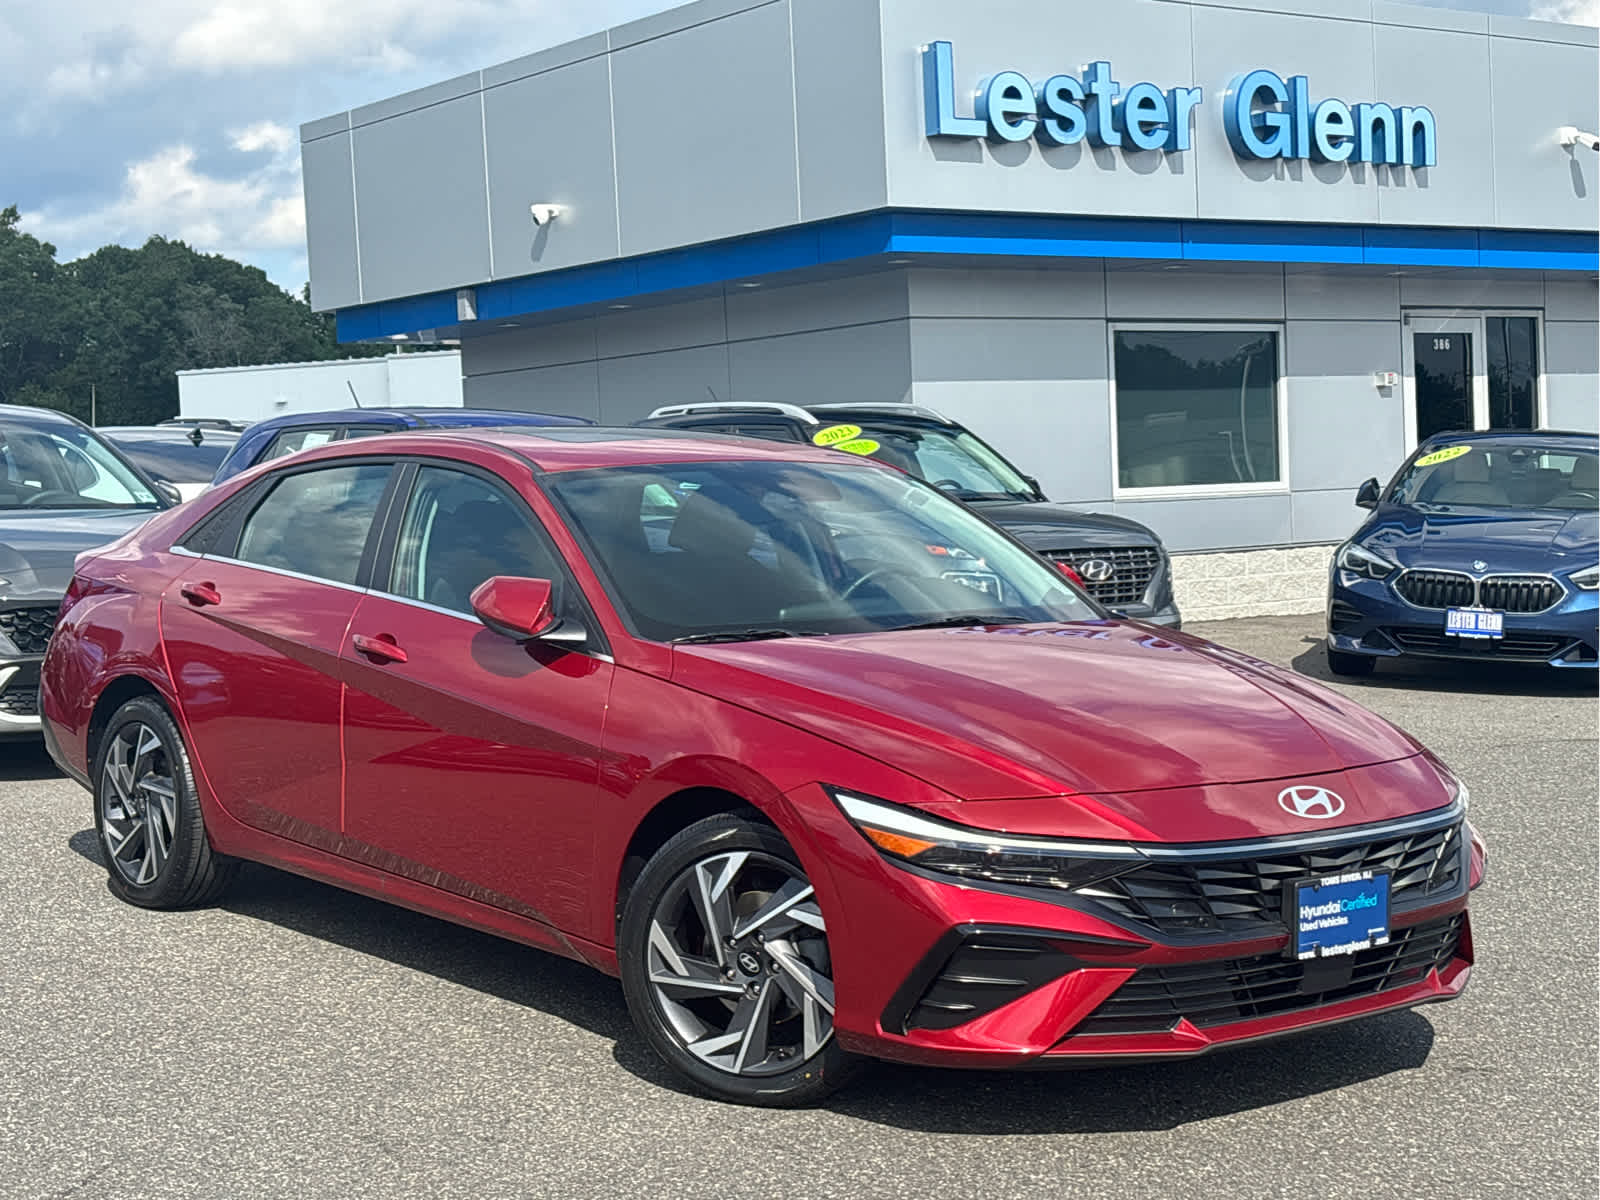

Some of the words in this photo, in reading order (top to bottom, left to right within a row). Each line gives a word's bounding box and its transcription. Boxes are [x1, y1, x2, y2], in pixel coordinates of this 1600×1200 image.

[922, 41, 1202, 151] Lester
[1224, 69, 1437, 167] Glenn
[822, 427, 854, 442] 2023
[1425, 447, 1461, 464] 2022
[1448, 610, 1475, 630] LESTER
[1478, 612, 1503, 632] GLENN
[1300, 921, 1318, 931] Used
[1319, 916, 1348, 928] Vehicles
